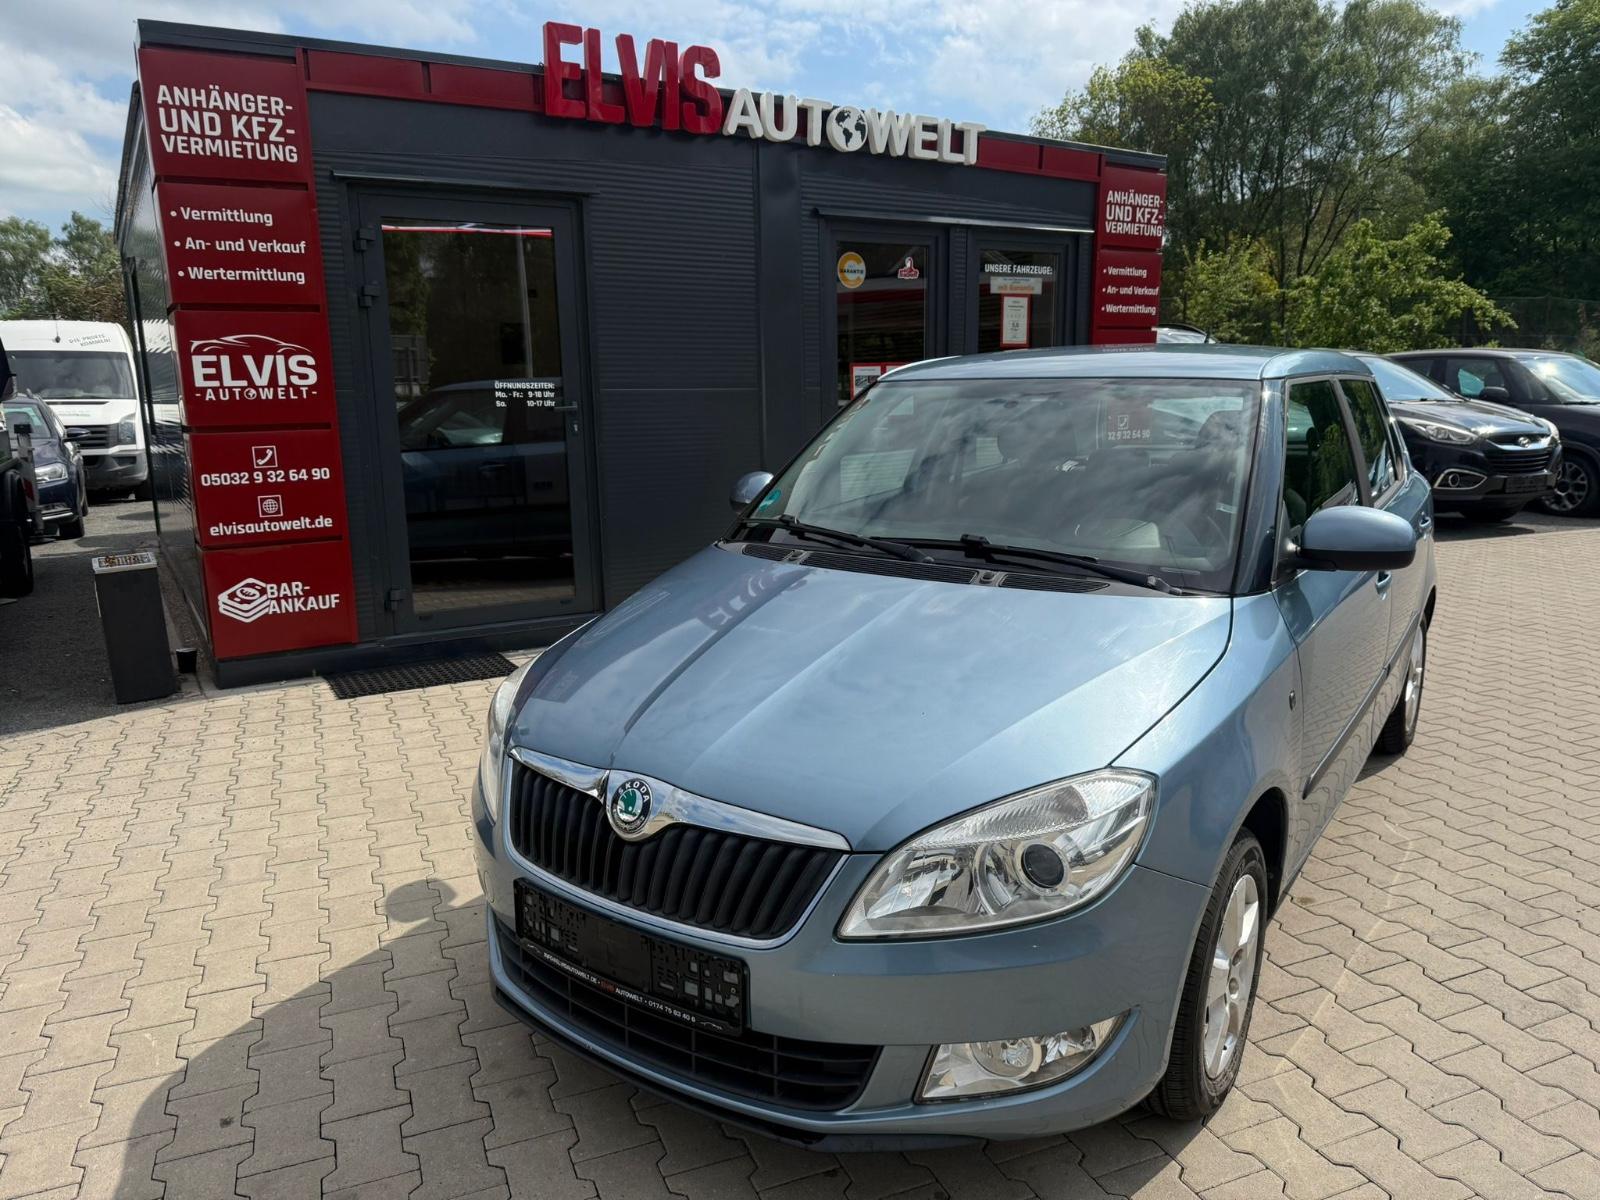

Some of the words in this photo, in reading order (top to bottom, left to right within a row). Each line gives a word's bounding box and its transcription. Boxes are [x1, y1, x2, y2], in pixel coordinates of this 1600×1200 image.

[543, 21, 724, 135] ELVIS
[157, 84, 293, 116] ANHÄNGER-
[159, 107, 221, 136] UND
[232, 117, 295, 142] KFZ-
[160, 134, 298, 163] VERMIETUNG
[1106, 189, 1163, 208] ANHÄNGER-
[180, 206, 273, 227] Vermittlung
[1106, 204, 1132, 222] UND
[1136, 208, 1163, 224] KFZ-
[1105, 221, 1162, 237] VERMIETUNG
[185, 237, 211, 250] An-
[216, 237, 245, 252] und
[248, 239, 306, 254] Verkauf
[187, 266, 306, 285] Wertermittlung
[985, 264, 1011, 272] UNSERE
[1013, 265, 1053, 275] FAHRZEUGE:
[1107, 266, 1147, 278] Vermittlung
[1107, 286, 1119, 294] An-
[1120, 286, 1132, 295] und
[1134, 287, 1159, 296] Verkauf
[1106, 304, 1156, 316] Wertermittlung
[191, 354, 317, 388] ELVIS
[494, 380, 555, 389] ÖFFNUNGSZEITEN:
[543, 390, 555, 398] Uhr
[201, 471, 249, 487] 05032
[253, 471, 262, 484] 9
[267, 470, 286, 483] 32
[288, 469, 307, 482] 64
[311, 467, 330, 480] 90
[209, 516, 333, 537] elvisautowelt.de
[266, 581, 310, 597] BAR-
[268, 593, 340, 615] ANKAUF
